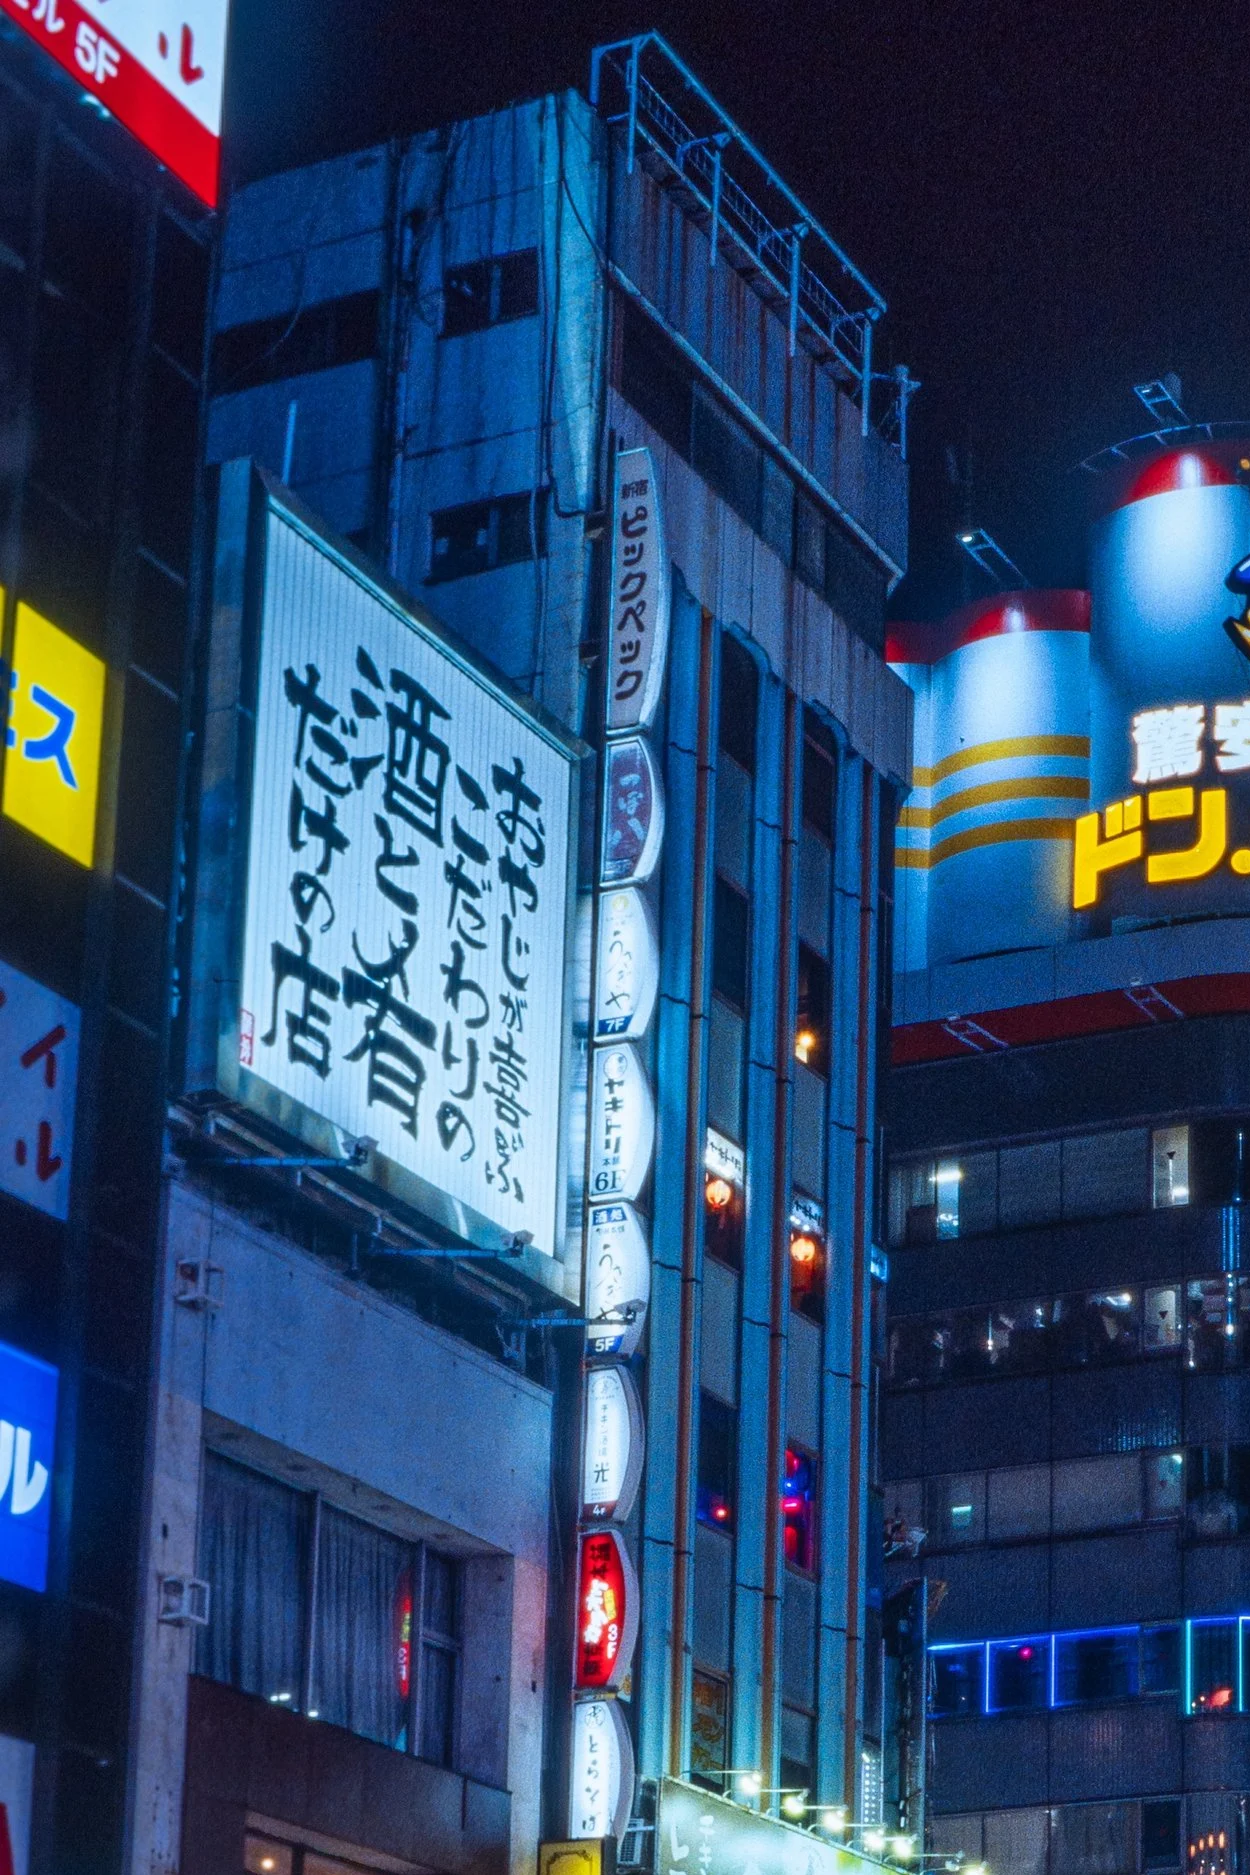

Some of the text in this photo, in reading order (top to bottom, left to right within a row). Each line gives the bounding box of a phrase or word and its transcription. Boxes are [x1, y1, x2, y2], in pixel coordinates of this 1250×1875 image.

[74, 21, 120, 84] 5F
[605, 1018, 624, 1033] 7F
[594, 1168, 627, 1193] 6F
[595, 1336, 616, 1353] 5F
